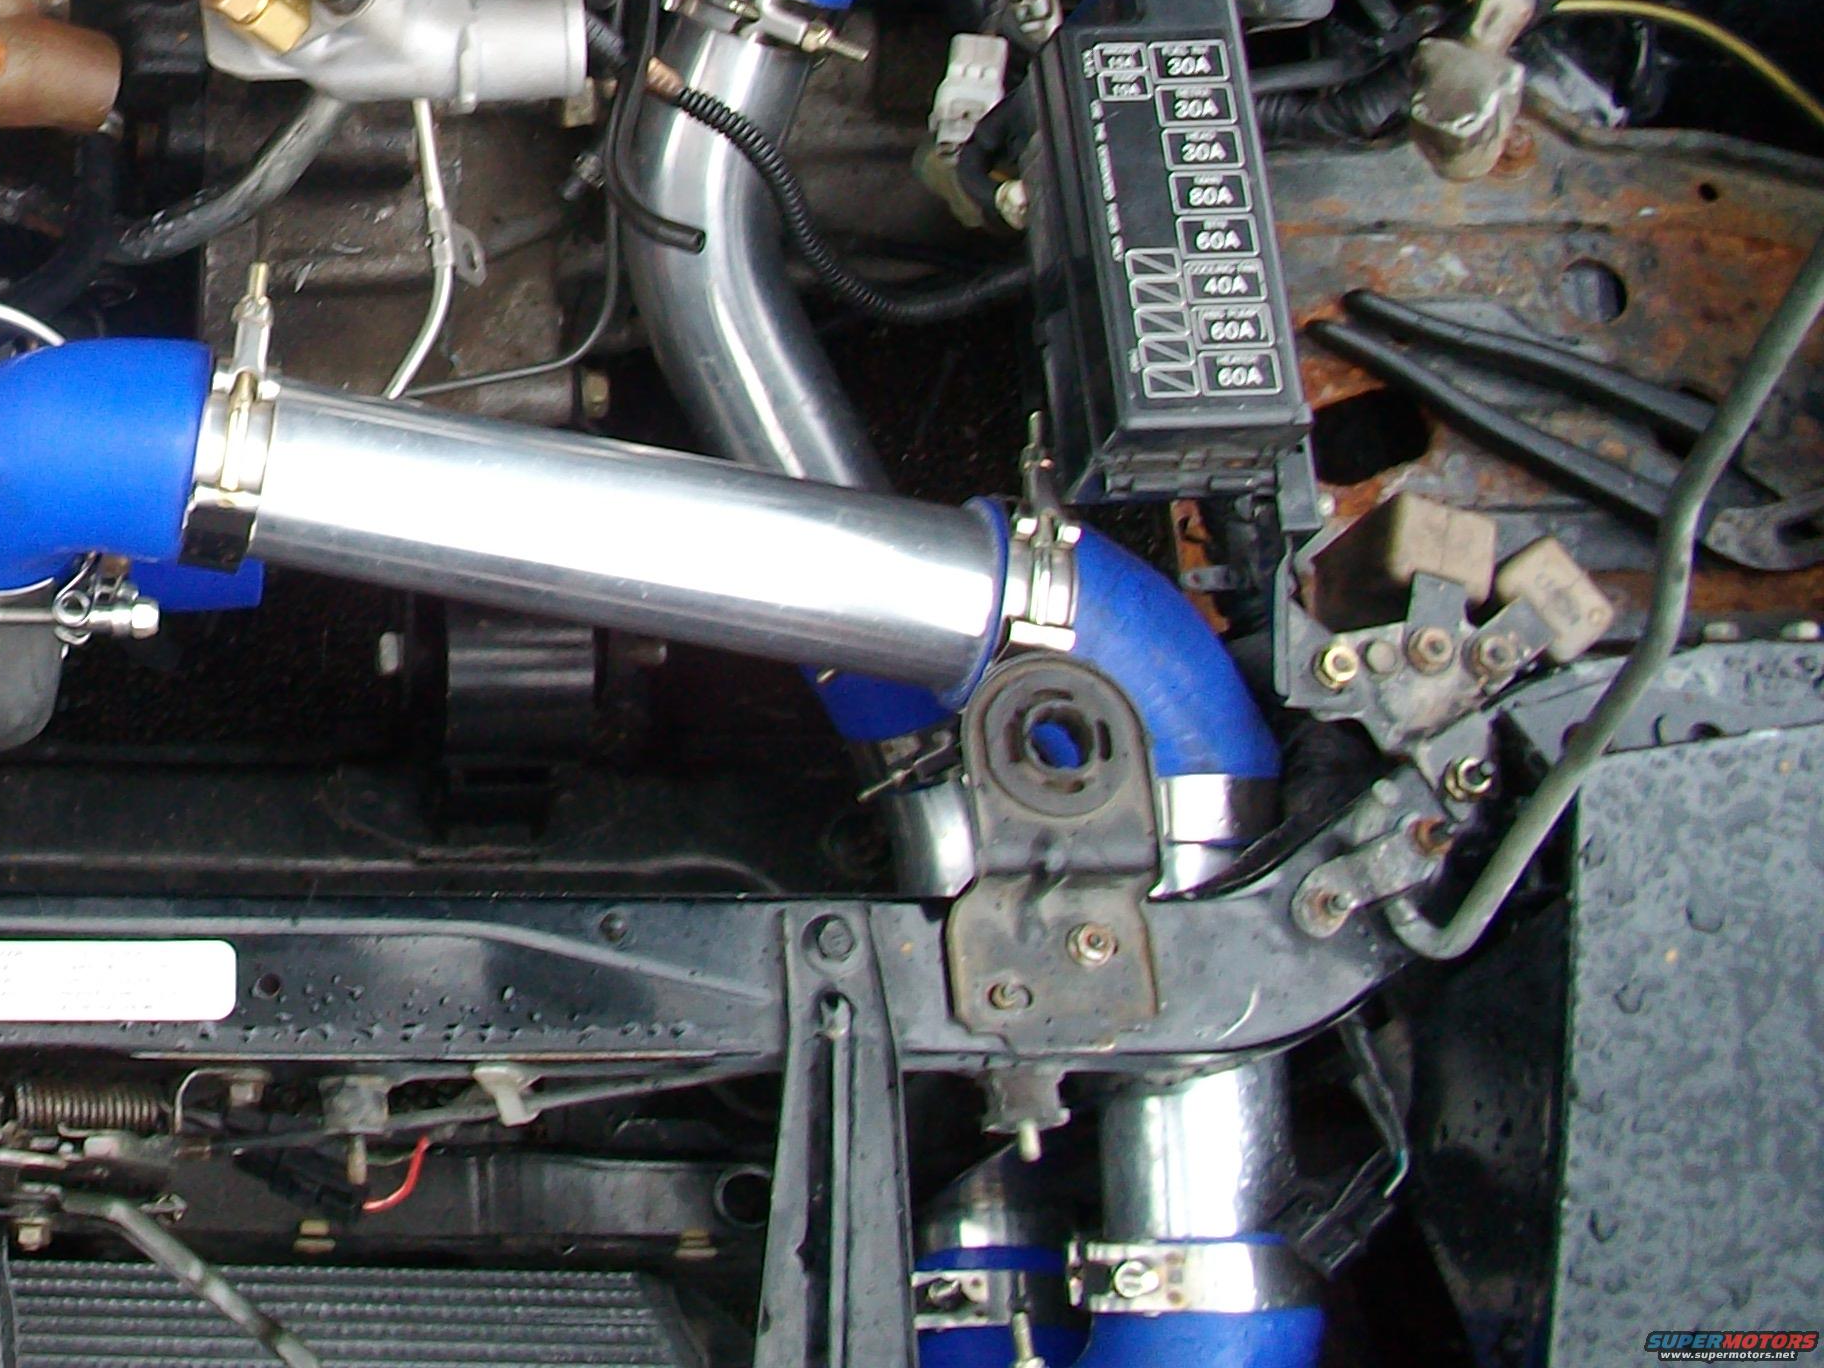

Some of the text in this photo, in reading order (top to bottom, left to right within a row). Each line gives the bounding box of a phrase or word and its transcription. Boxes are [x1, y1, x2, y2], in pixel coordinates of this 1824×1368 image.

[1167, 56, 1212, 76] 30A
[1174, 98, 1220, 119] 30A
[1181, 141, 1226, 162] 30A
[1196, 229, 1242, 251] 60A
[1203, 274, 1249, 295] 40A
[1210, 319, 1257, 341] 60A
[1217, 364, 1264, 387] 60A
